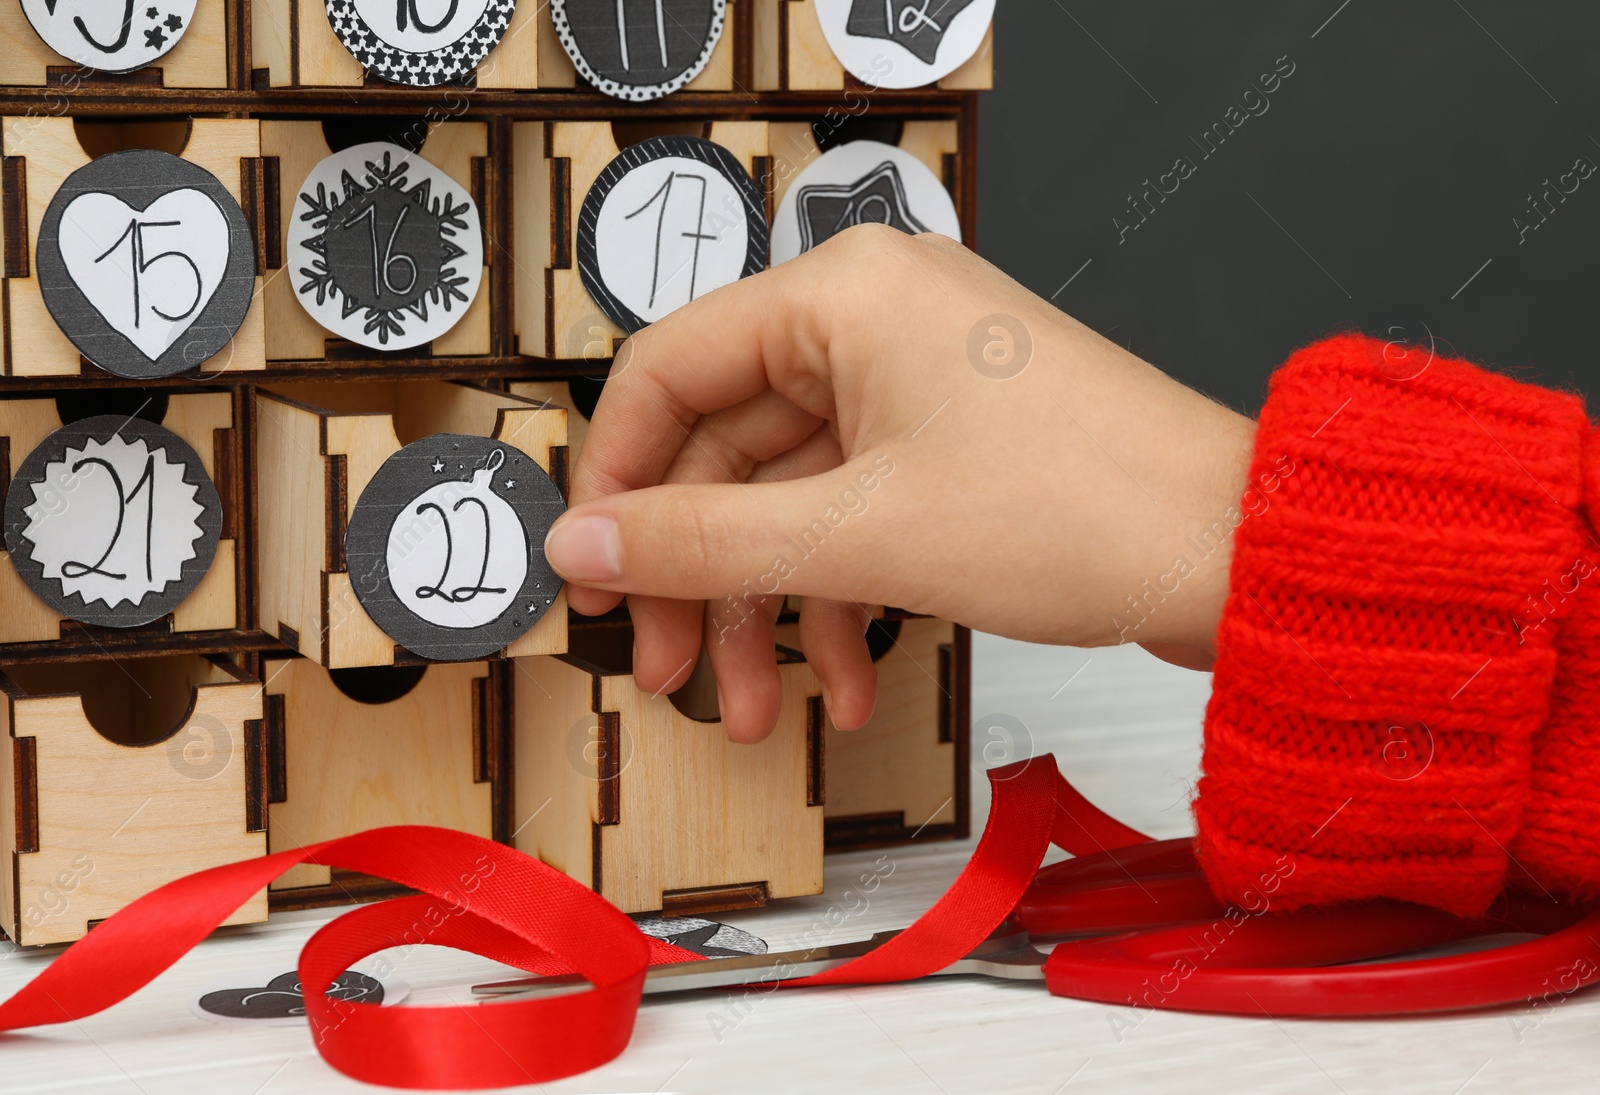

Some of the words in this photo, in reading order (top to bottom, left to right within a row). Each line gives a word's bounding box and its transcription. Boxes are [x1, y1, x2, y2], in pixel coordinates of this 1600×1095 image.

[94, 217, 202, 328] 15
[344, 203, 420, 298] 16
[624, 170, 718, 310] 17
[60, 453, 155, 583] 21
[415, 496, 507, 603] 22
